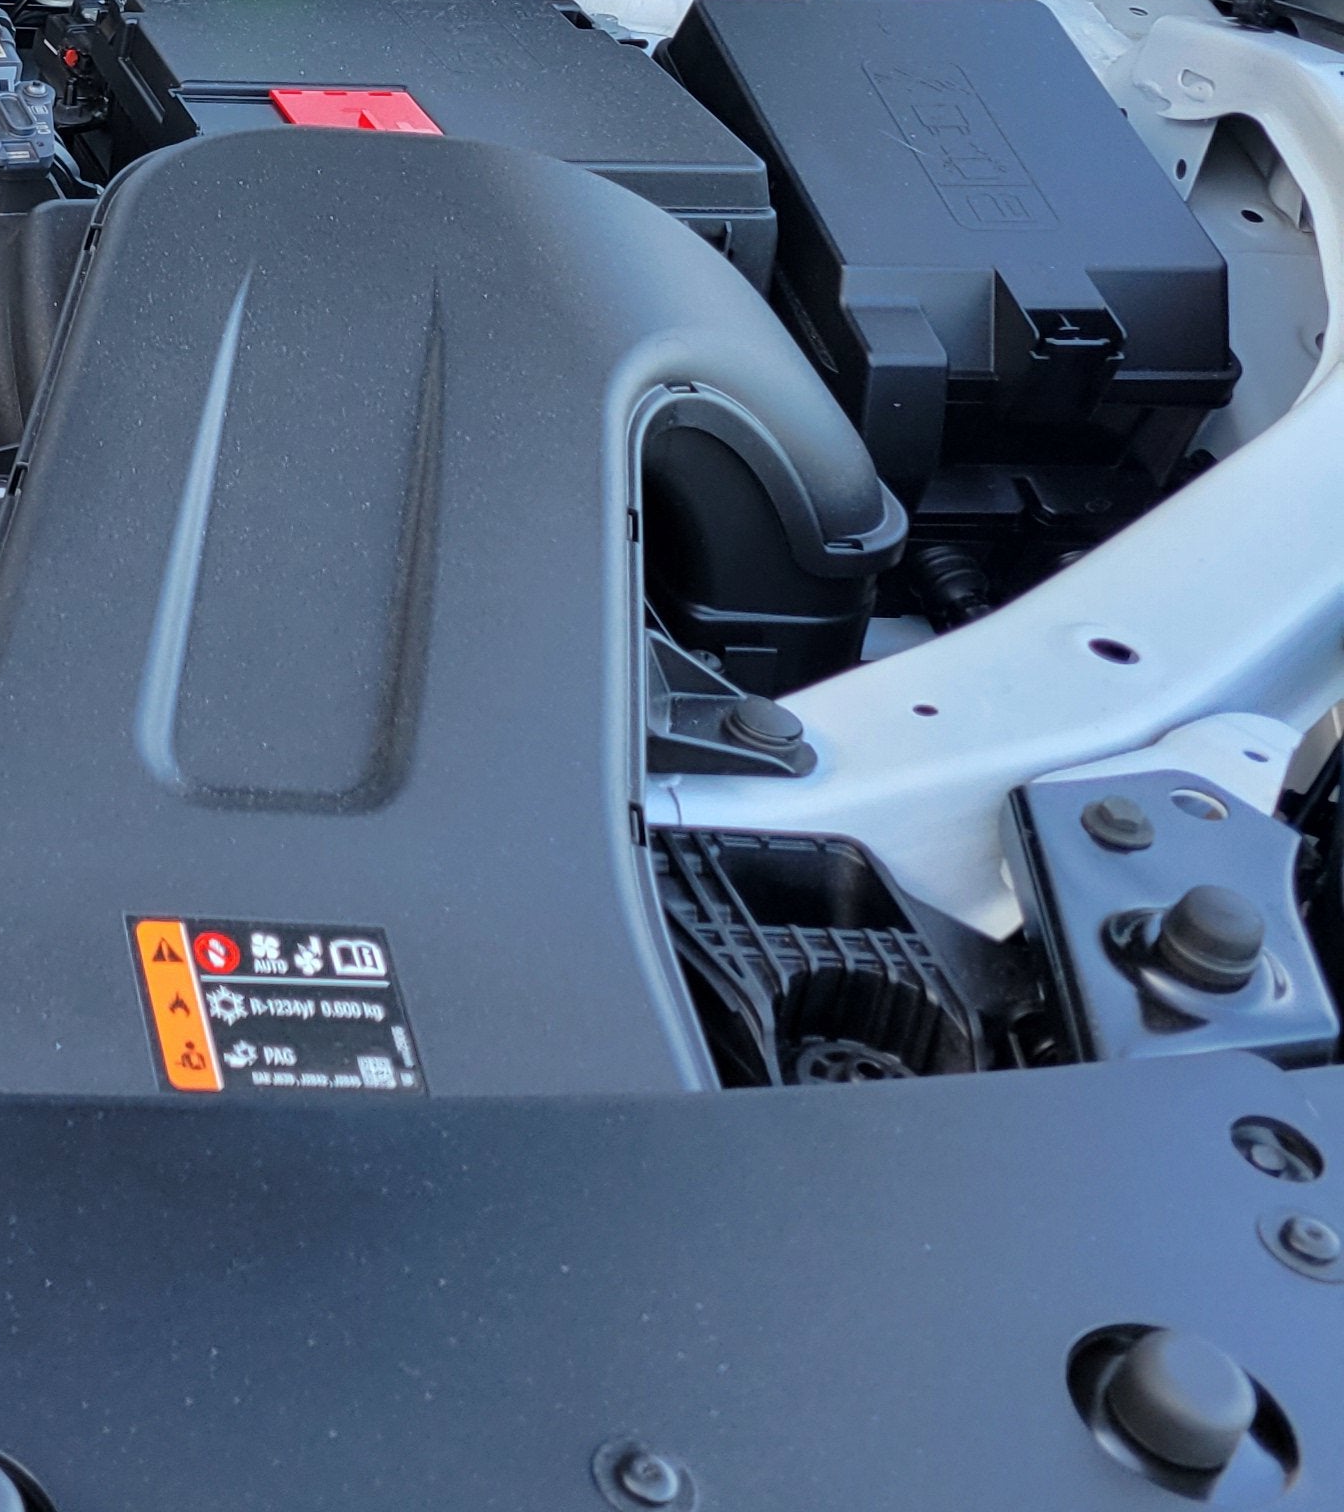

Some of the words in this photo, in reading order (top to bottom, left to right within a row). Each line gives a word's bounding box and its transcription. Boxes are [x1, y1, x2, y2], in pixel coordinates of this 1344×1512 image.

[253, 958, 289, 975] AUTO
[249, 997, 315, 1021] R-1234yf
[263, 1046, 297, 1066] PAG
